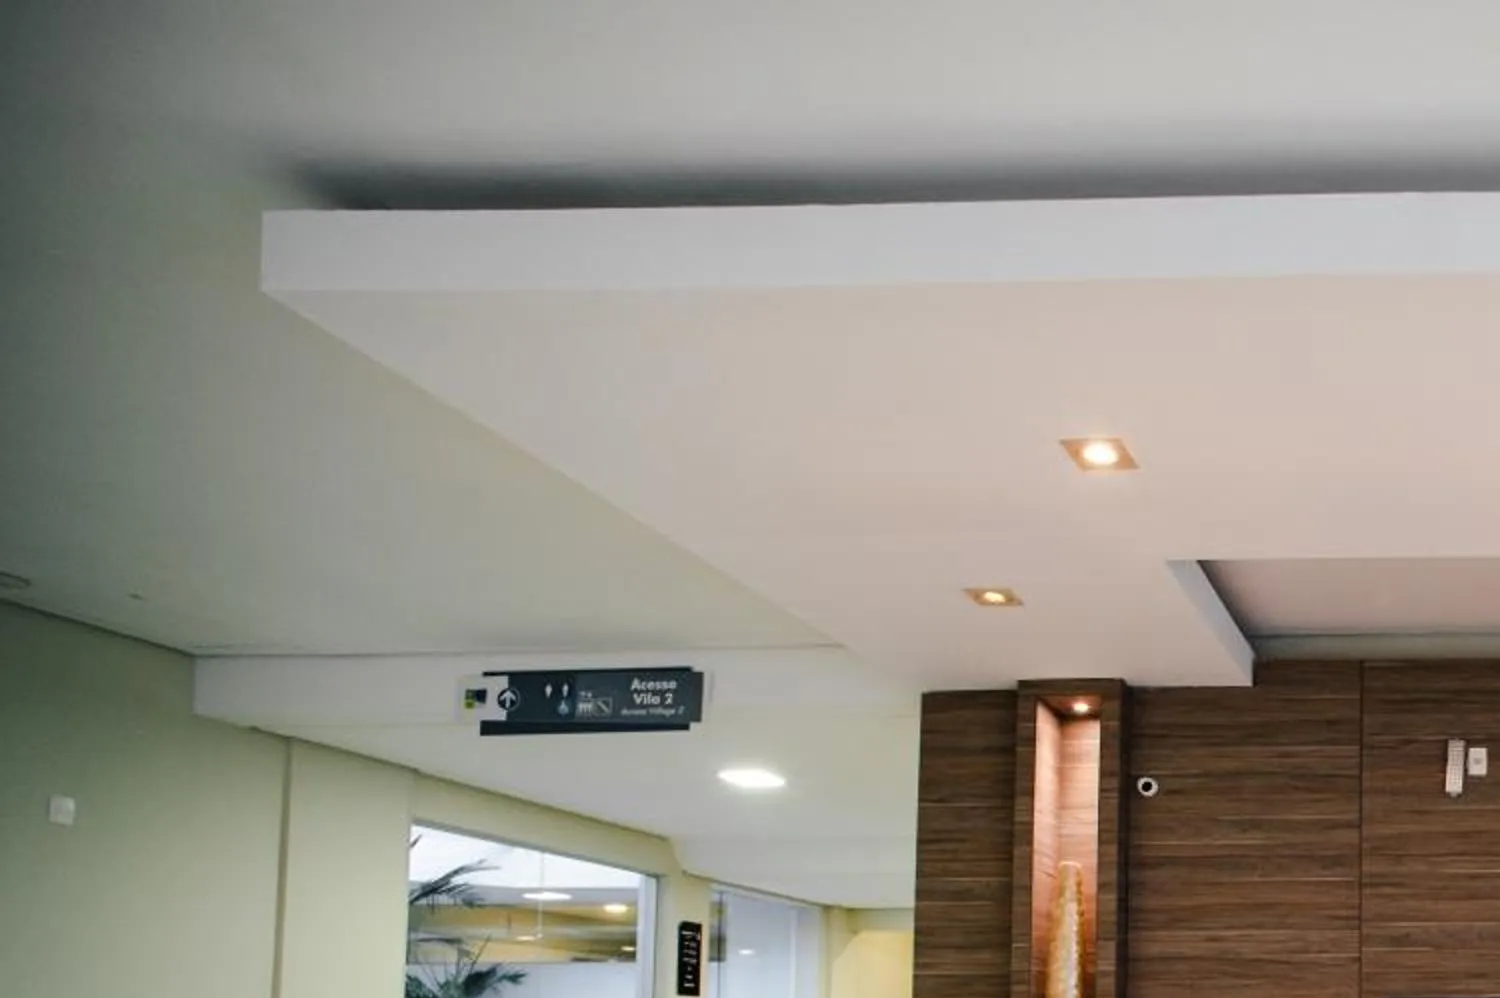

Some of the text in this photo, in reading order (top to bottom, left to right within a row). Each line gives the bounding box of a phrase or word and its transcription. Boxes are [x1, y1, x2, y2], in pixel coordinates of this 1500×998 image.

[631, 677, 677, 690] Acesso
[633, 692, 673, 704] Vila 2
